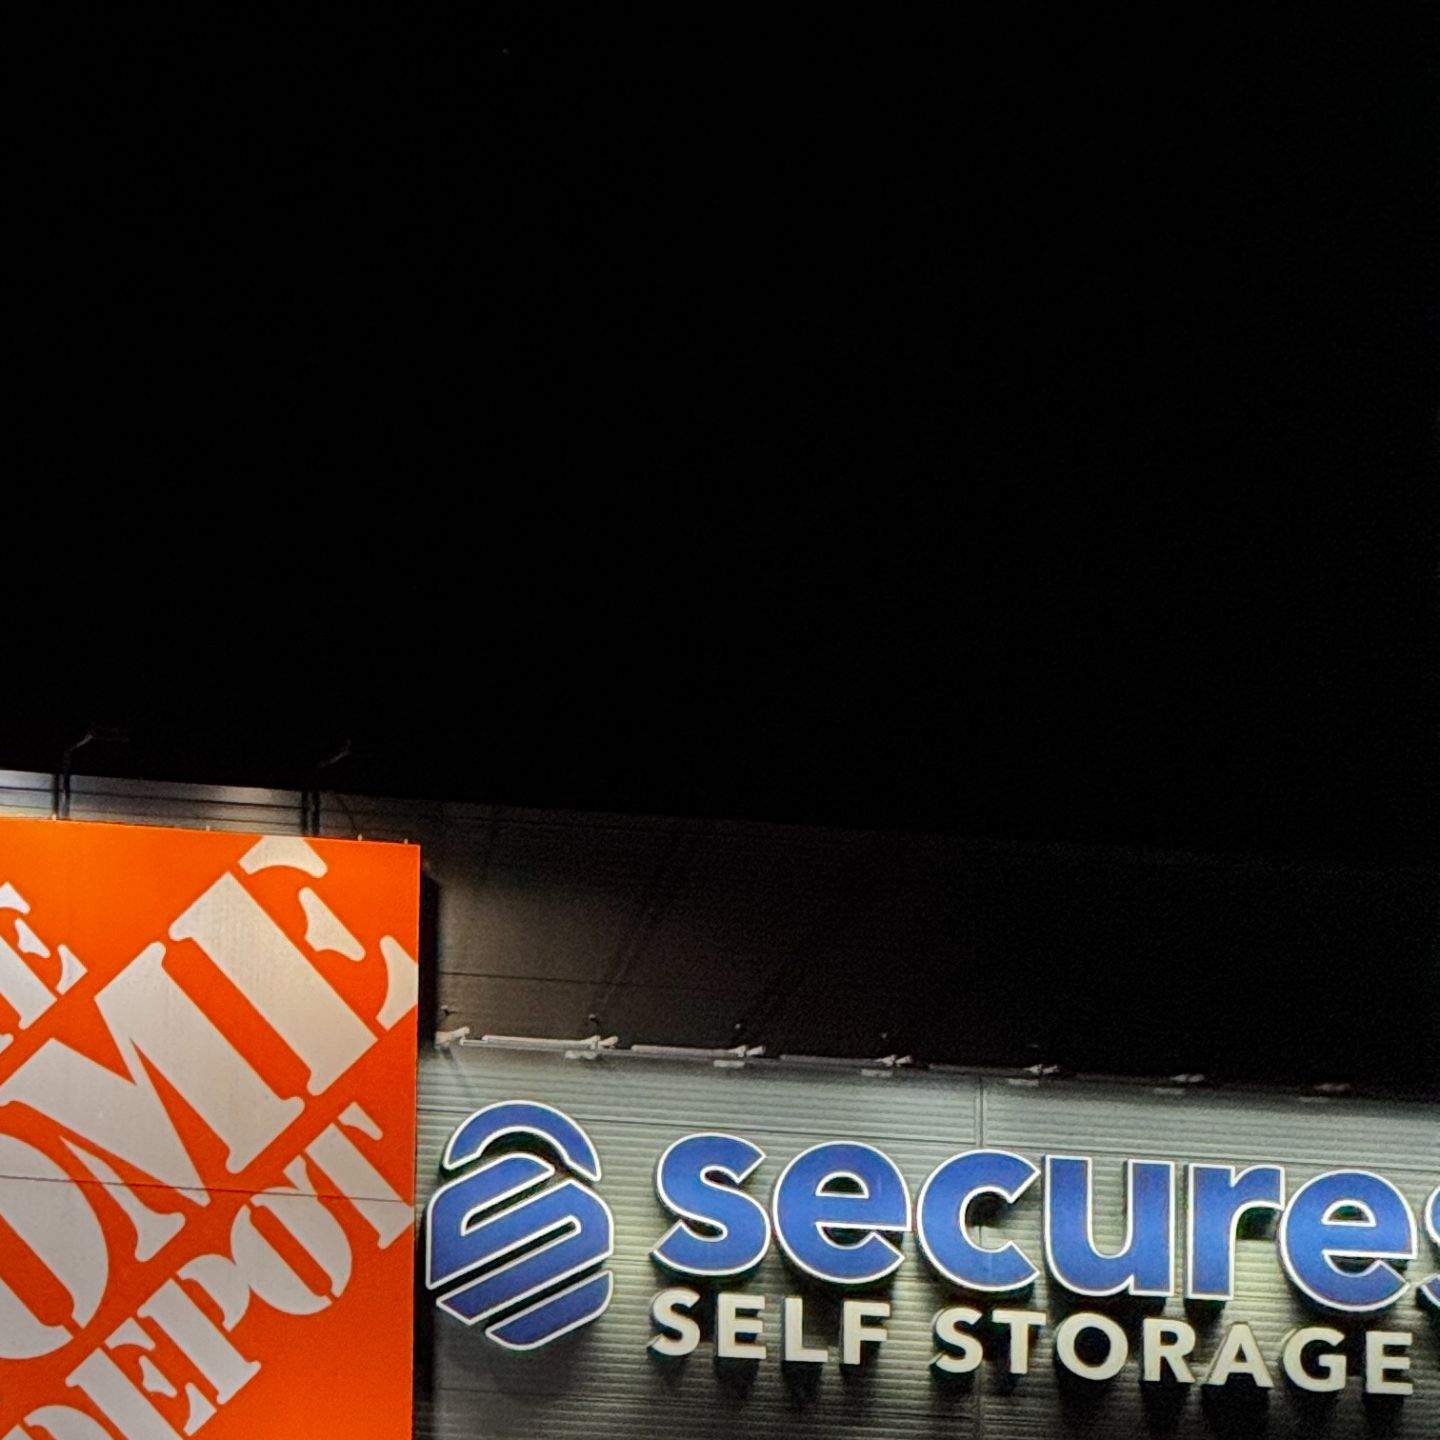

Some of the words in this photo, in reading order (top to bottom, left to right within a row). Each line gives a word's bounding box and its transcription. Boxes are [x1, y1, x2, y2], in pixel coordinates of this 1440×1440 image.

[651, 1132, 1440, 1313] secure
[648, 1288, 892, 1366] SELF
[931, 1306, 1415, 1396] STORAGE
